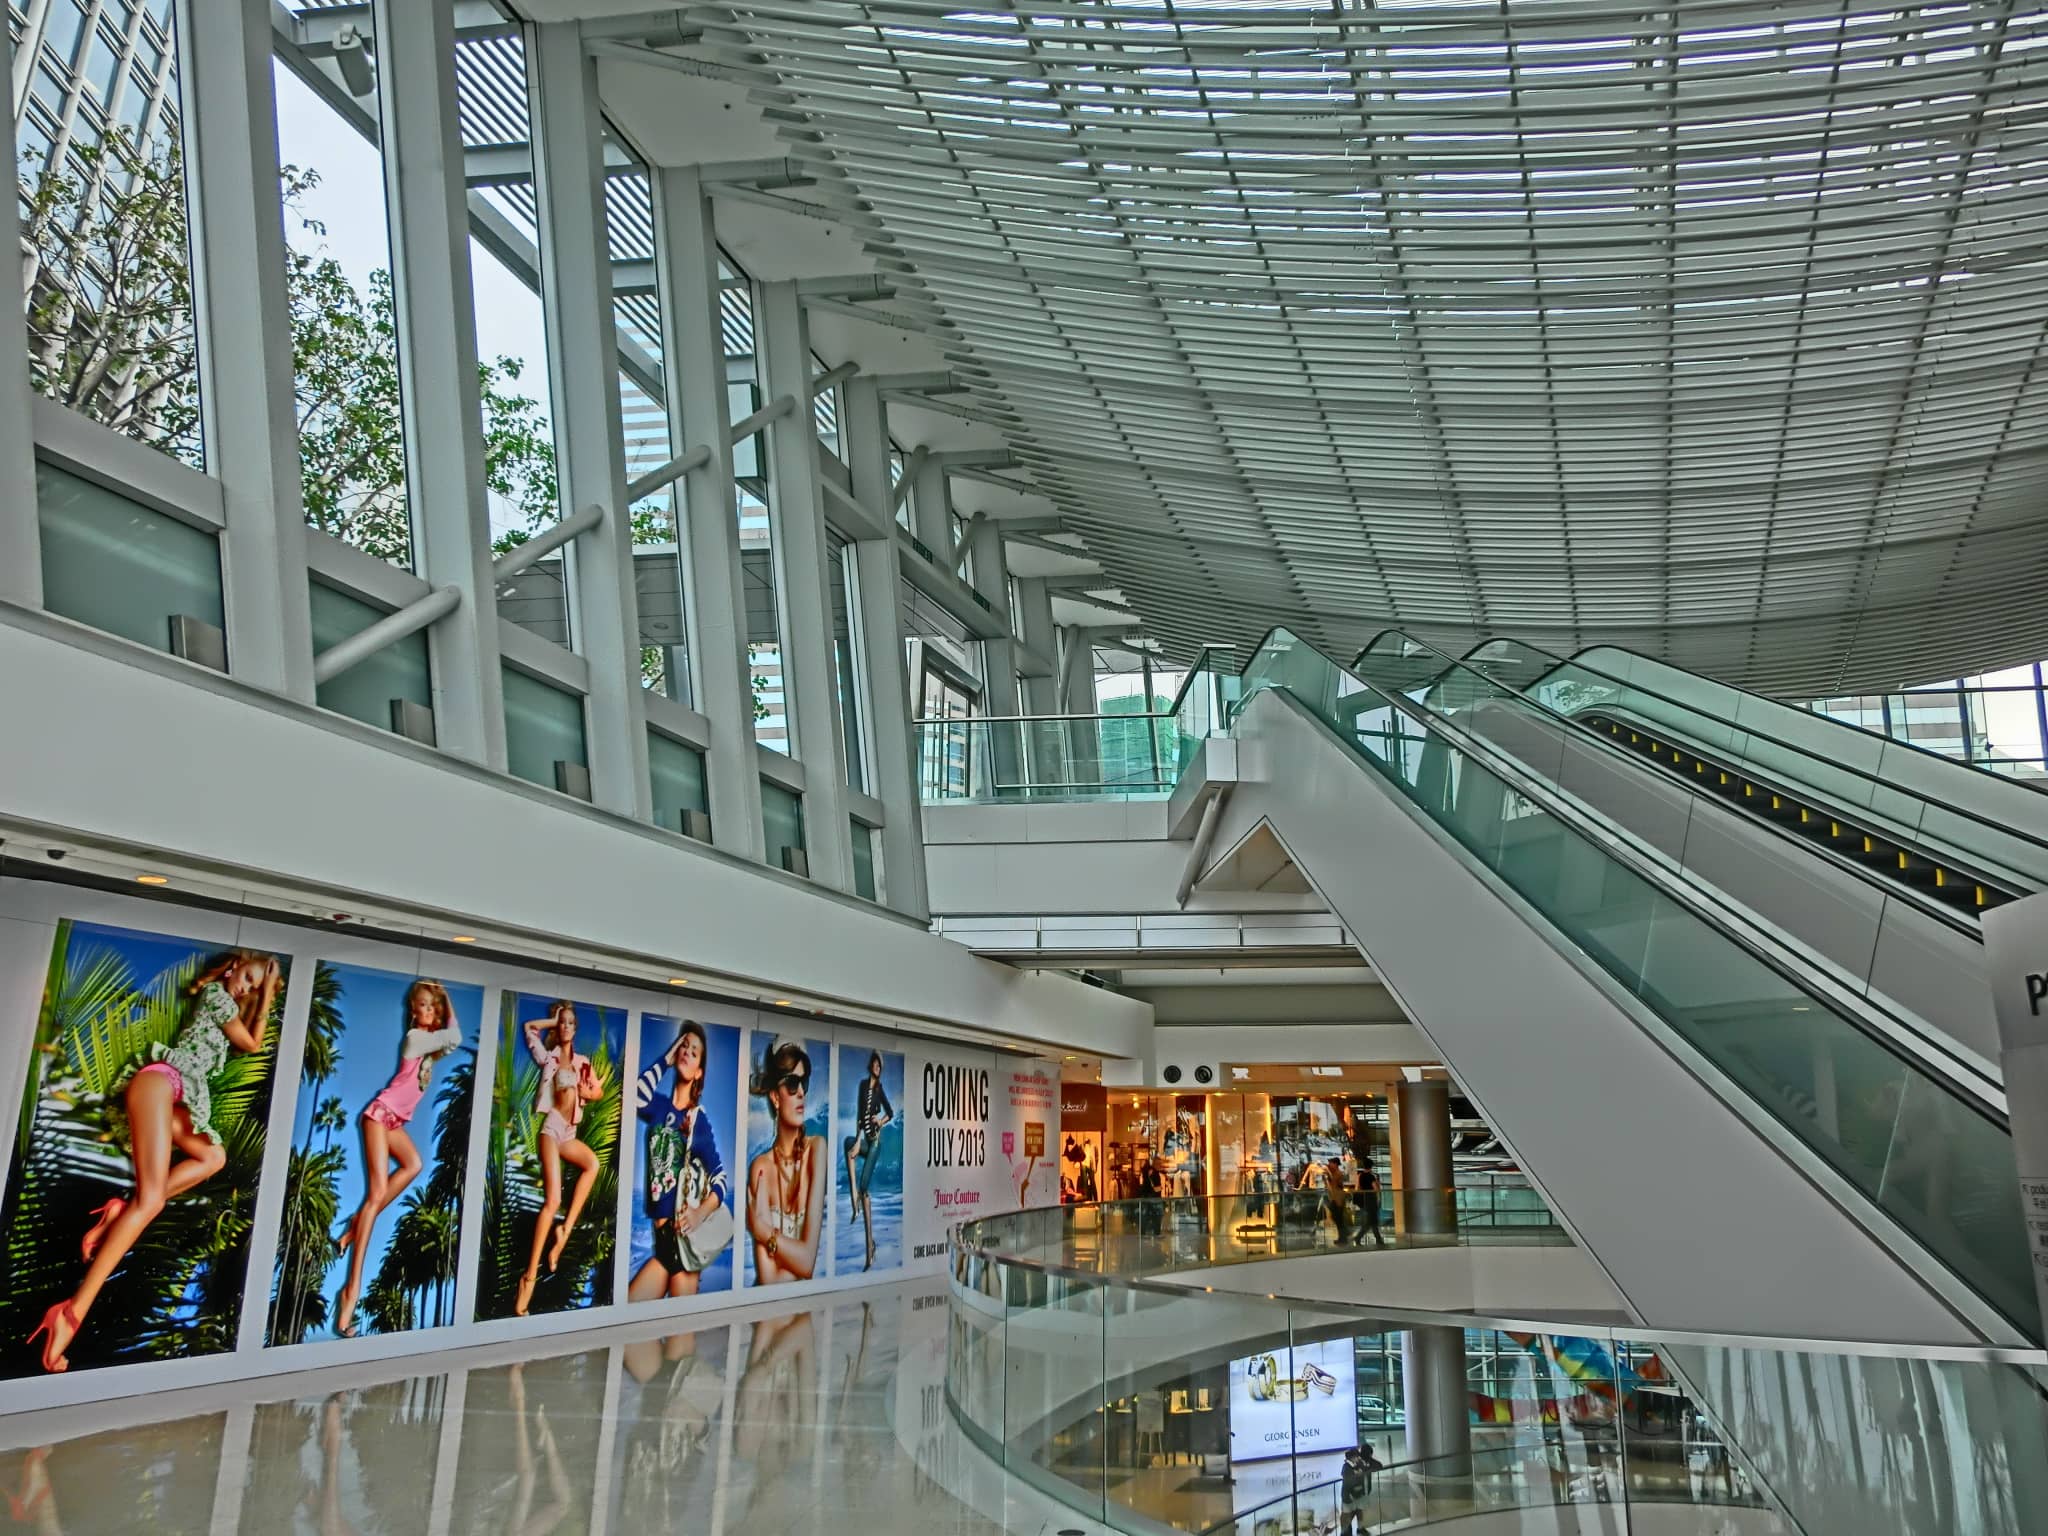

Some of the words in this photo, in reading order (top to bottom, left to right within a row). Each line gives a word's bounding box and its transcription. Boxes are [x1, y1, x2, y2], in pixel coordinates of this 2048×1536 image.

[923, 1062, 989, 1122] COMING
[927, 1127, 955, 1168] JULY
[958, 1128, 985, 1167] 2013
[934, 1189, 954, 1209] Juicy
[954, 1188, 980, 1205] Couture
[913, 1244, 926, 1258] COME
[926, 1243, 936, 1257] BACK
[937, 1242, 945, 1255] AND
[1264, 1431, 1290, 1442] GEORG
